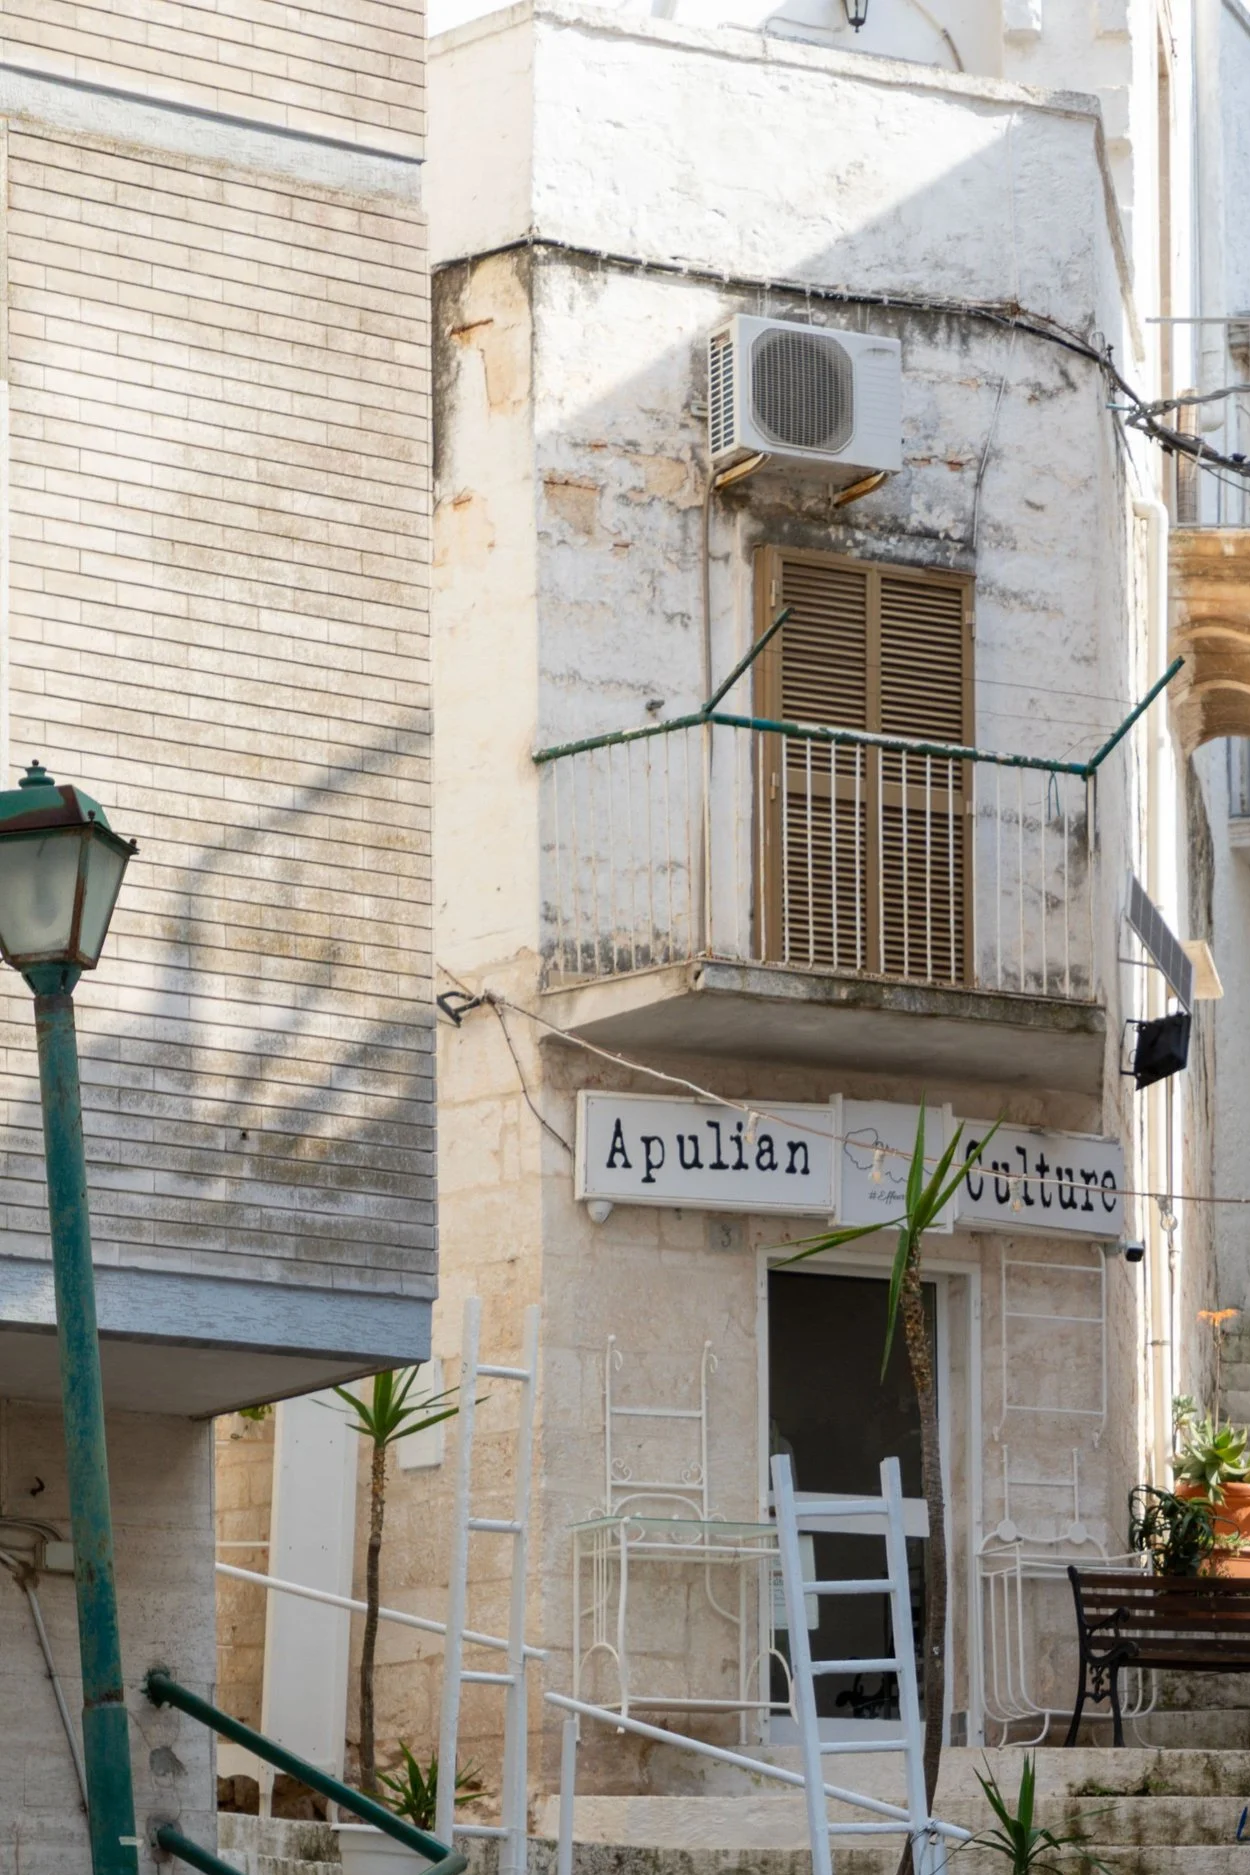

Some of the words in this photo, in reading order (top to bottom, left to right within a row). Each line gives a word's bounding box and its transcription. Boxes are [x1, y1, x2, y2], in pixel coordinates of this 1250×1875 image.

[606, 1117, 810, 1183] Apulian
[965, 1139, 1117, 1213] Culture
[720, 1224, 732, 1248] 3
